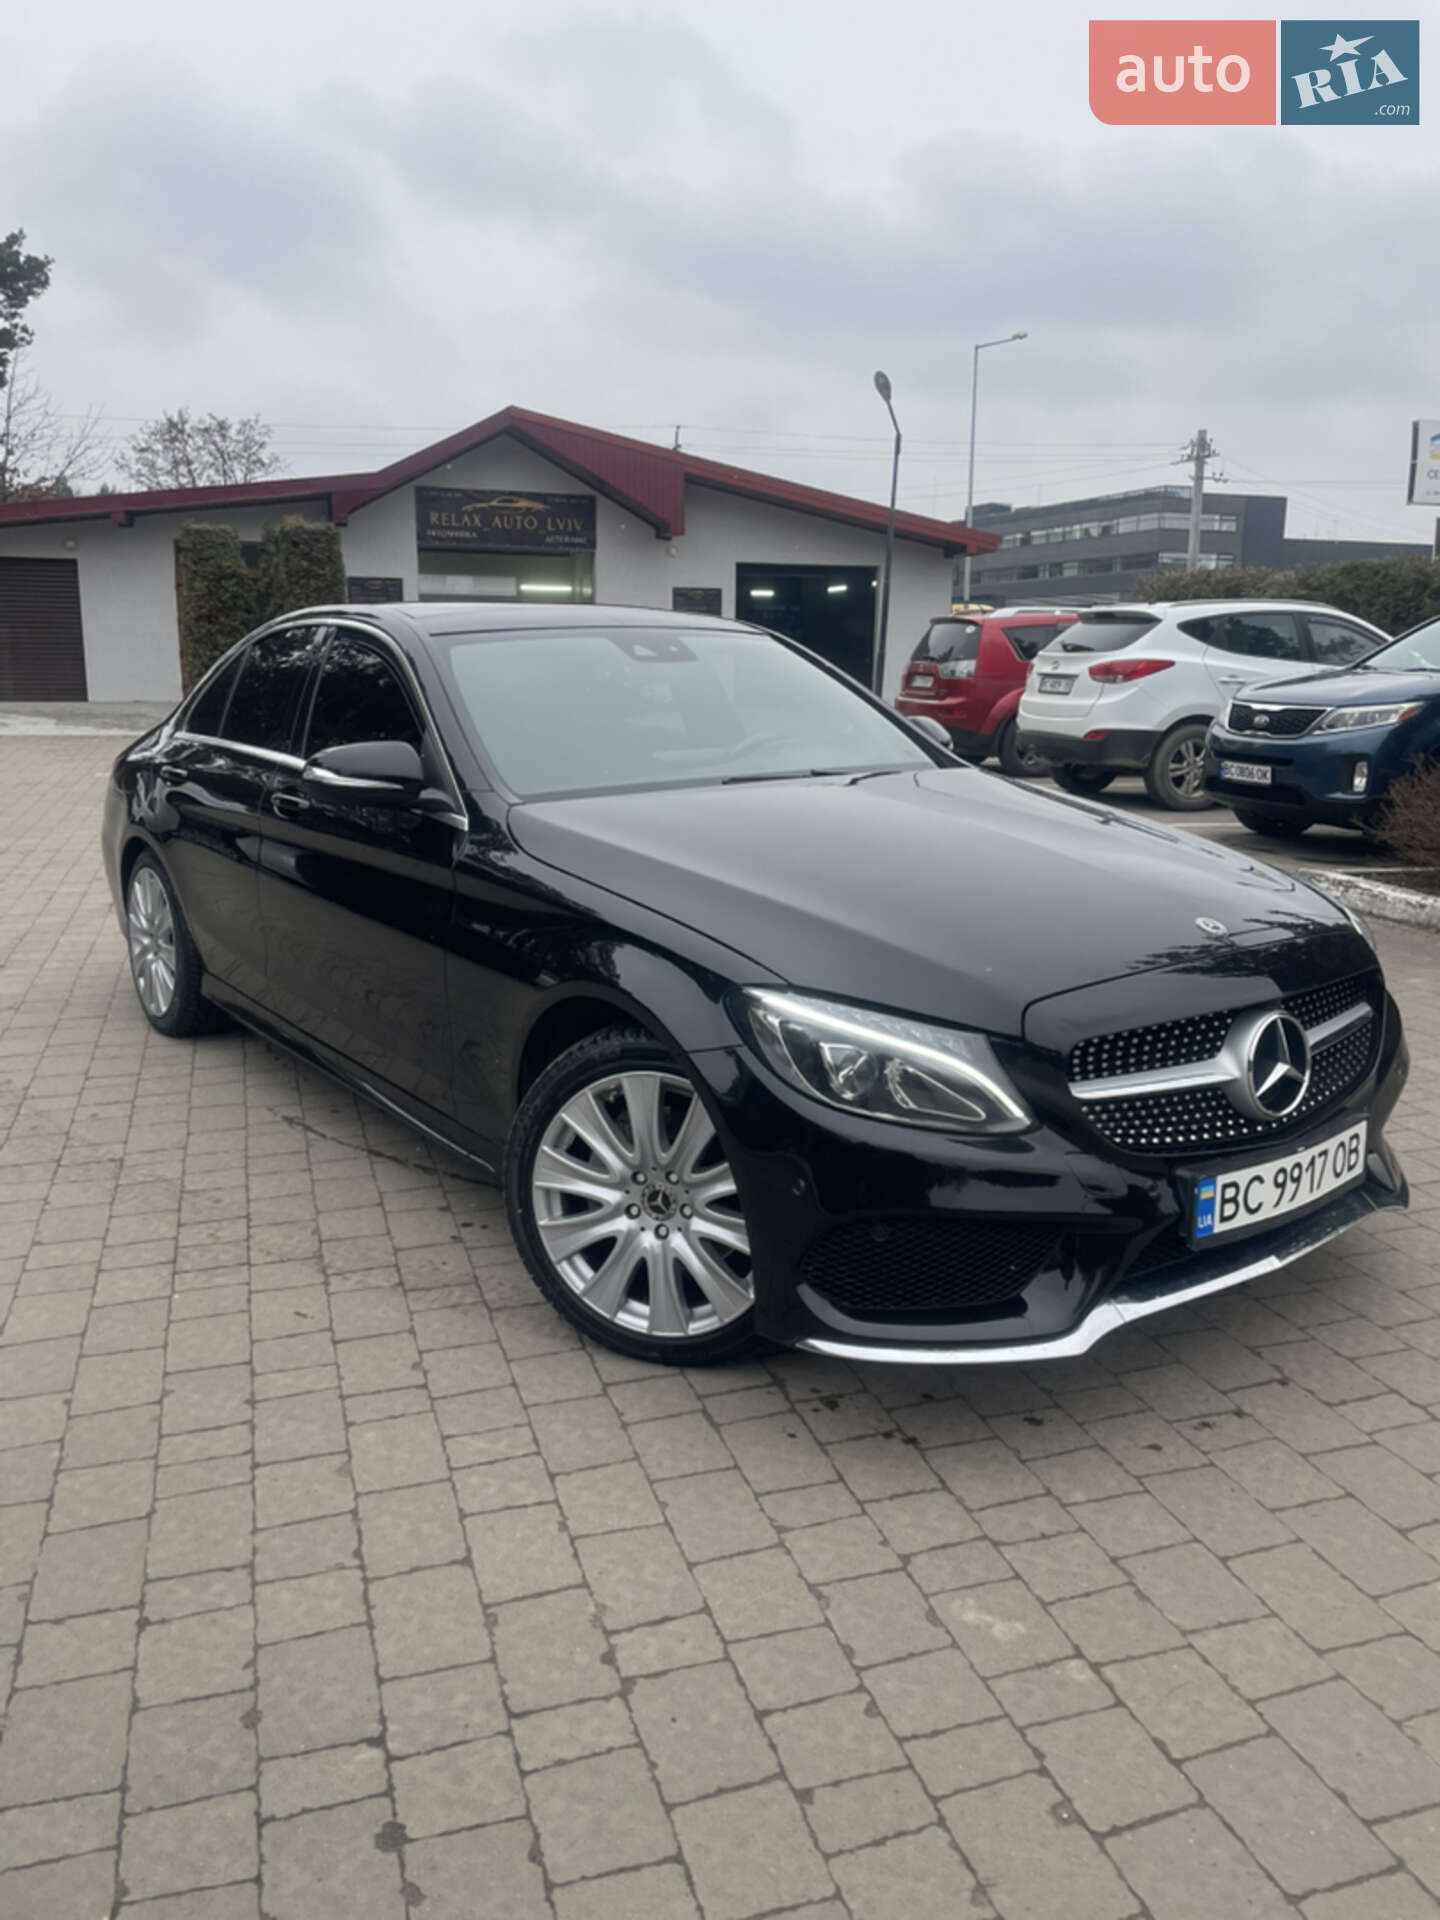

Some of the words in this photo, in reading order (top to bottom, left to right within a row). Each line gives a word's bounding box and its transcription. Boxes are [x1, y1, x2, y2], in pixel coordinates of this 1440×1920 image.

[1219, 1174, 1265, 1224] BC
[1272, 1148, 1329, 1209] 9917
[1197, 1215, 1213, 1228] UA
